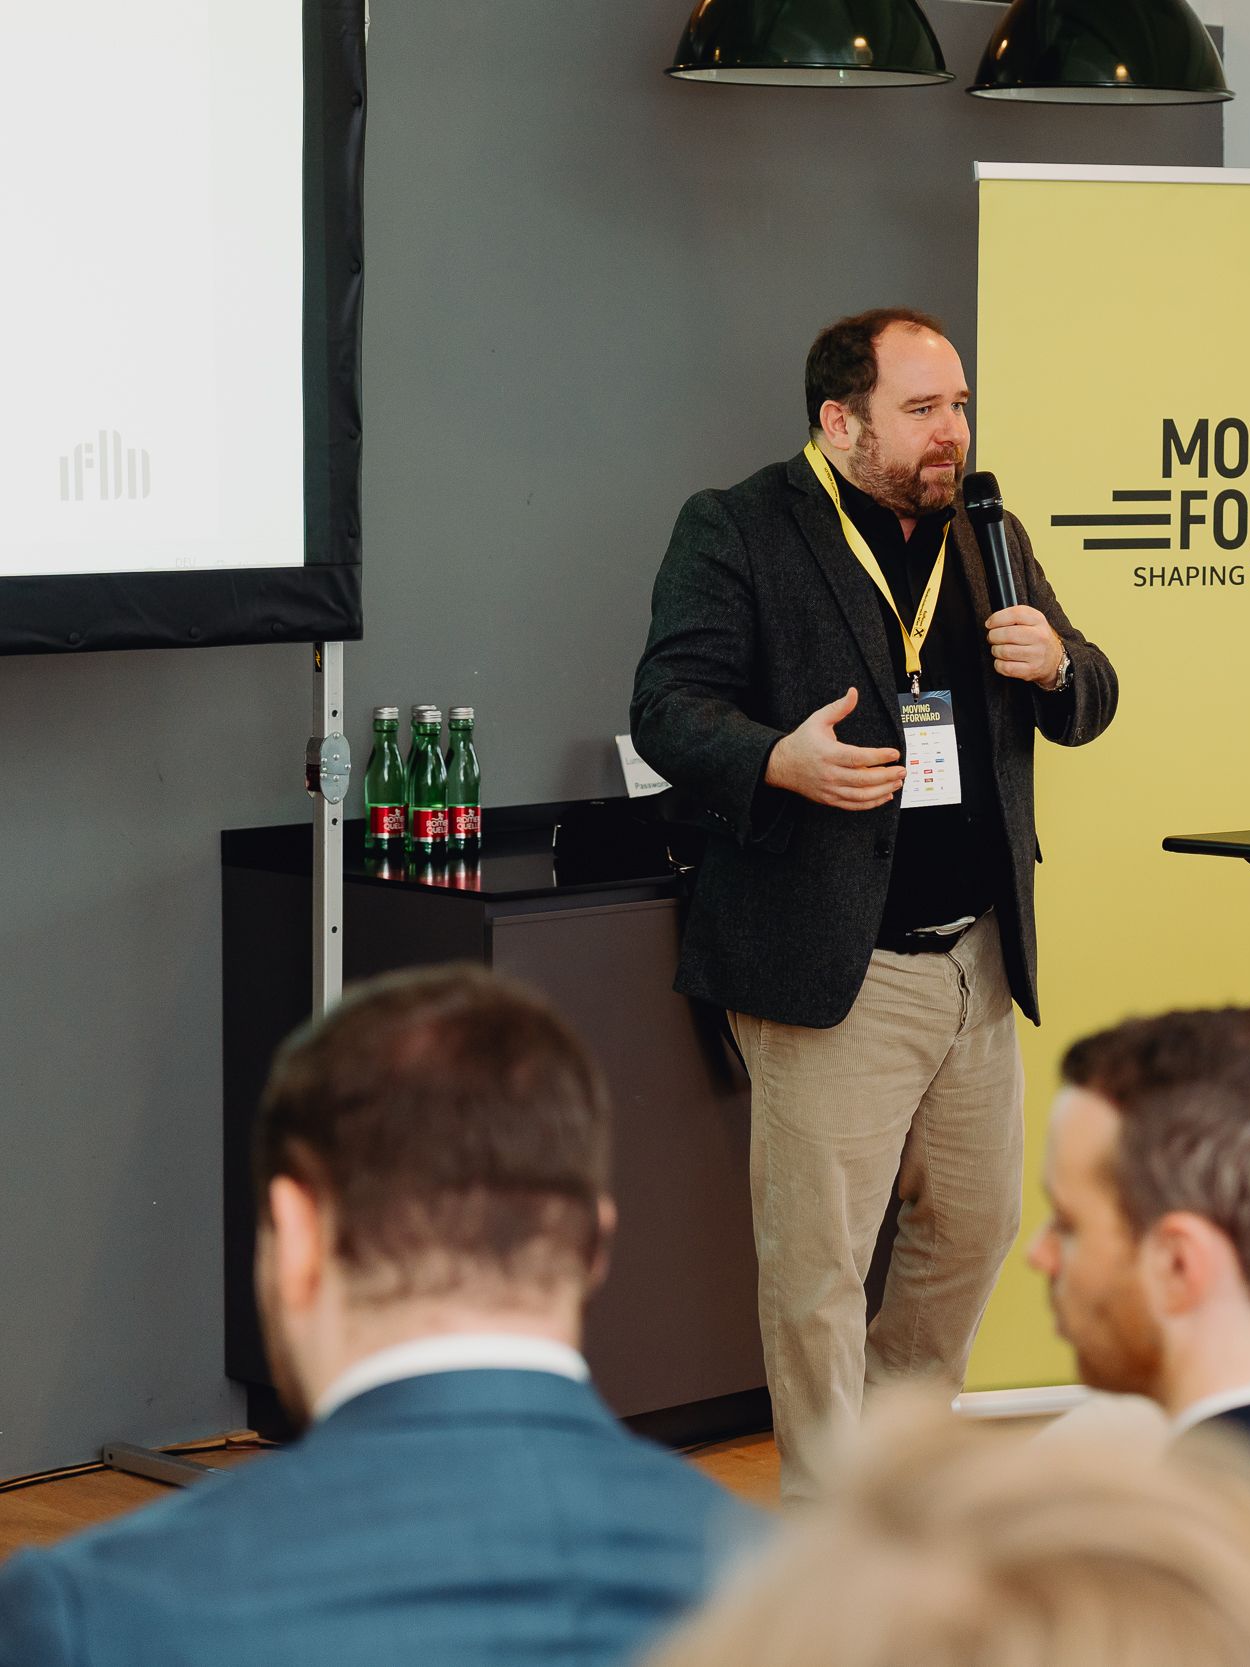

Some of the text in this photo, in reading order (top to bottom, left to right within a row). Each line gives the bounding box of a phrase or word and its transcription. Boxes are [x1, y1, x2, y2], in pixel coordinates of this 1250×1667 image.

[1133, 565, 1245, 587] SHAPING
[902, 704, 931, 715] MOVING
[904, 712, 941, 723] FORWARD
